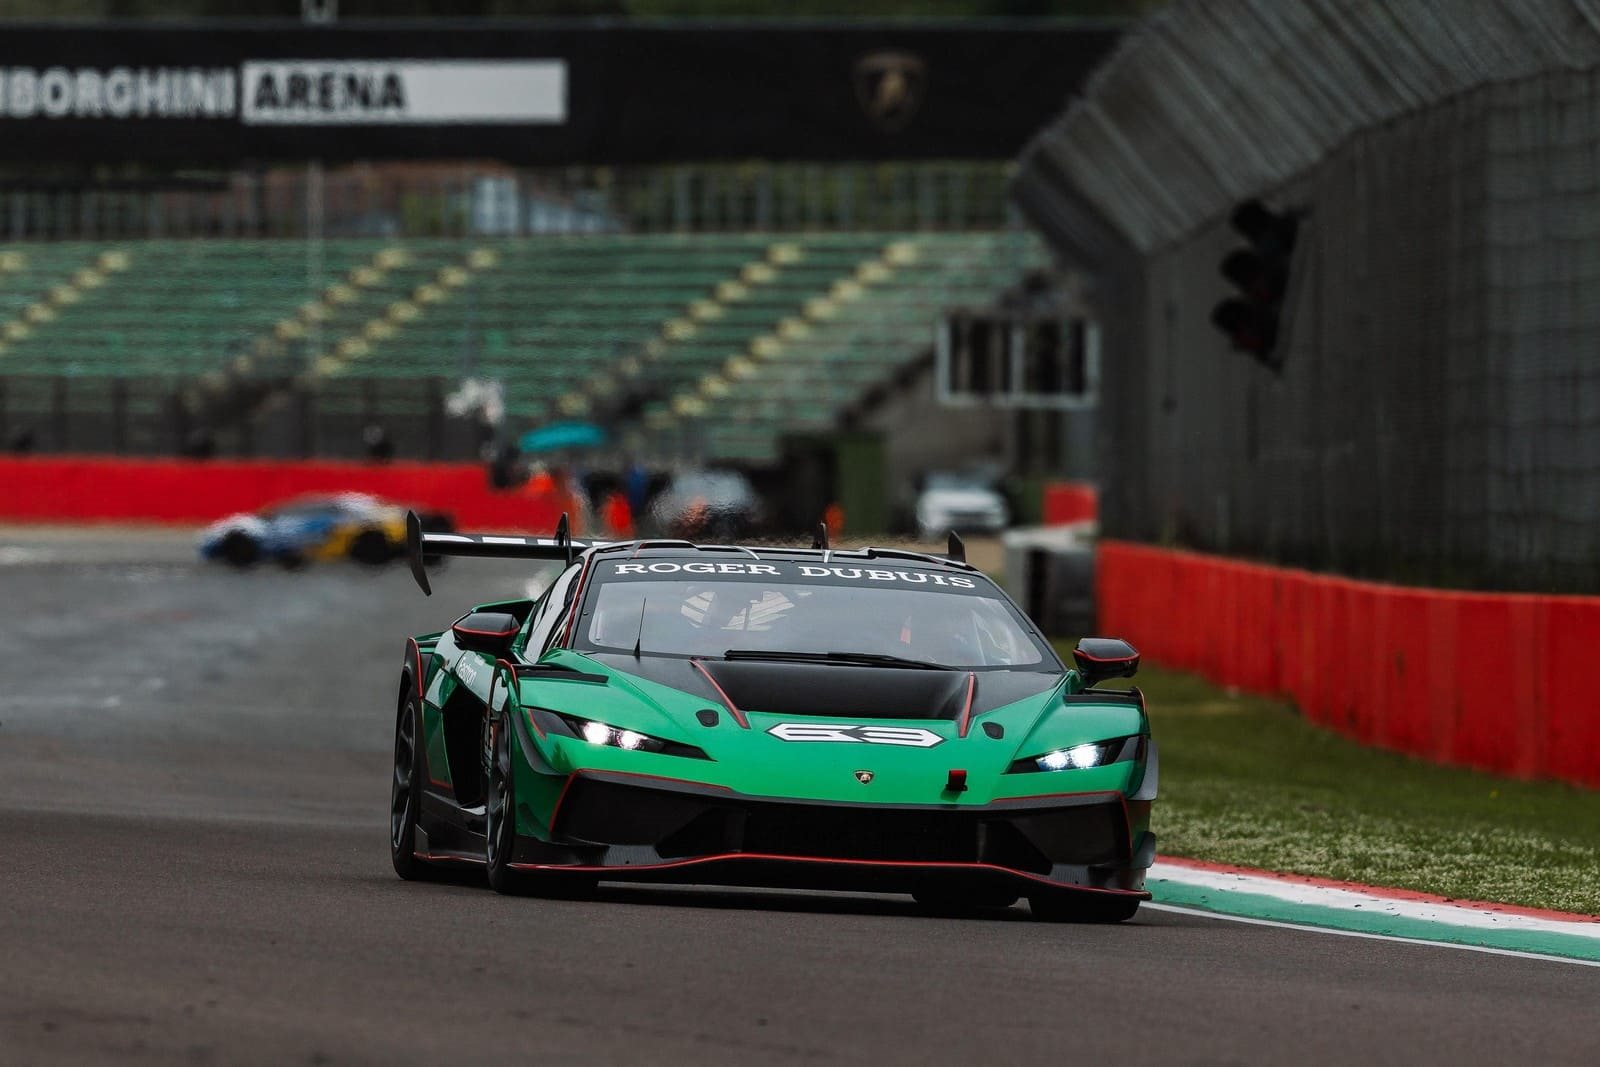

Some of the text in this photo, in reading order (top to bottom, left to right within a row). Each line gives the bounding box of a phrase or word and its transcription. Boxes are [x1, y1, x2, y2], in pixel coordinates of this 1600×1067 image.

[0, 66, 406, 118] BORGHINI ARENA
[614, 563, 975, 589] ROGER DUBUIS
